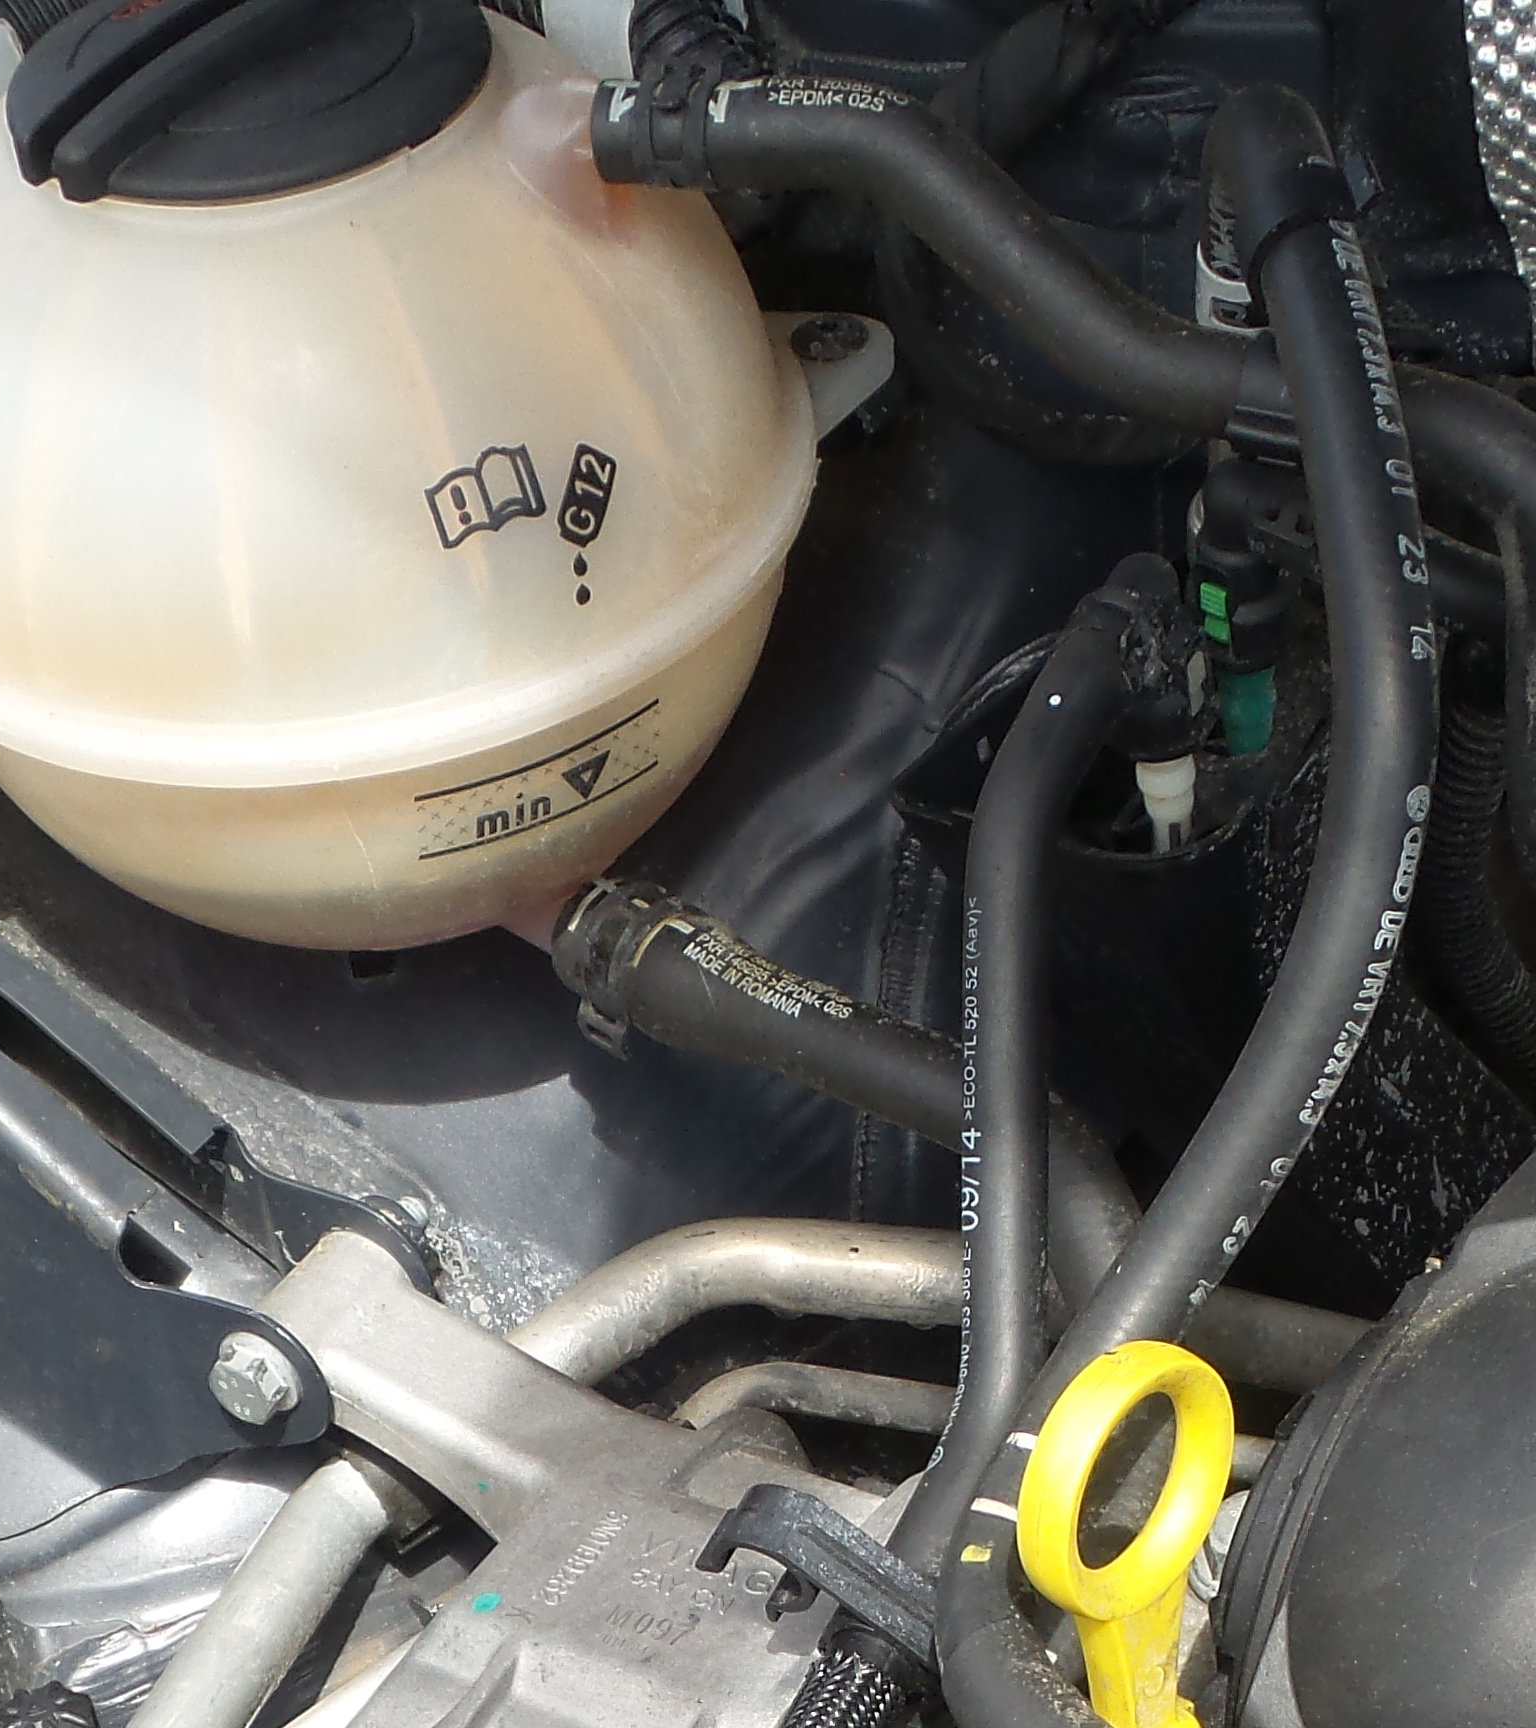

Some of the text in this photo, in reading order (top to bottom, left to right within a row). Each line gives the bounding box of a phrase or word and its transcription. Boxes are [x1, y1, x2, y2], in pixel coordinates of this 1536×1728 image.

[767, 89, 886, 113] >EPDM< 02S
[563, 451, 615, 536] G12
[1396, 531, 1430, 588] 23
[475, 794, 552, 839] min
[682, 941, 724, 976] MADE
[720, 963, 742, 987] IN
[737, 974, 804, 1018] ROMANIA
[695, 932, 724, 960] PXR
[766, 972, 824, 1011] >EPDM<
[821, 998, 854, 1022] 02S
[969, 966, 980, 990] 52
[964, 996, 980, 1031] 520
[962, 1036, 979, 1121] >ECO-TL
[961, 1126, 984, 1231] 09/14
